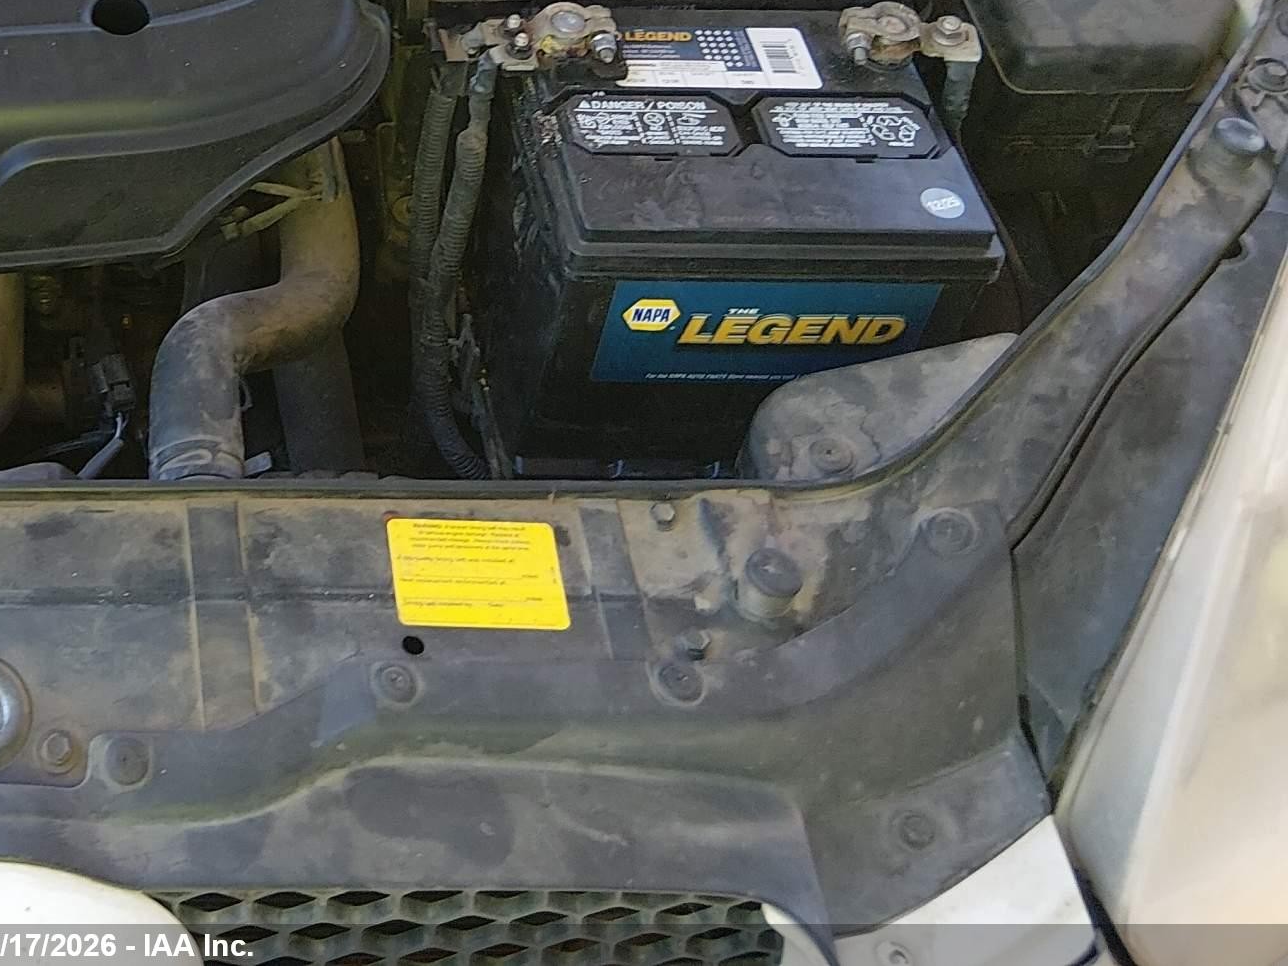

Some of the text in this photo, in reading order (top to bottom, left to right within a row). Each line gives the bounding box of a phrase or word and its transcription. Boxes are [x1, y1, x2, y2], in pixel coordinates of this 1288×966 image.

[624, 31, 692, 42] LEGEND
[591, 101, 645, 110] DANGER
[656, 100, 707, 110] POISON
[632, 307, 672, 323] NAPA
[677, 314, 906, 345] LEGEND
